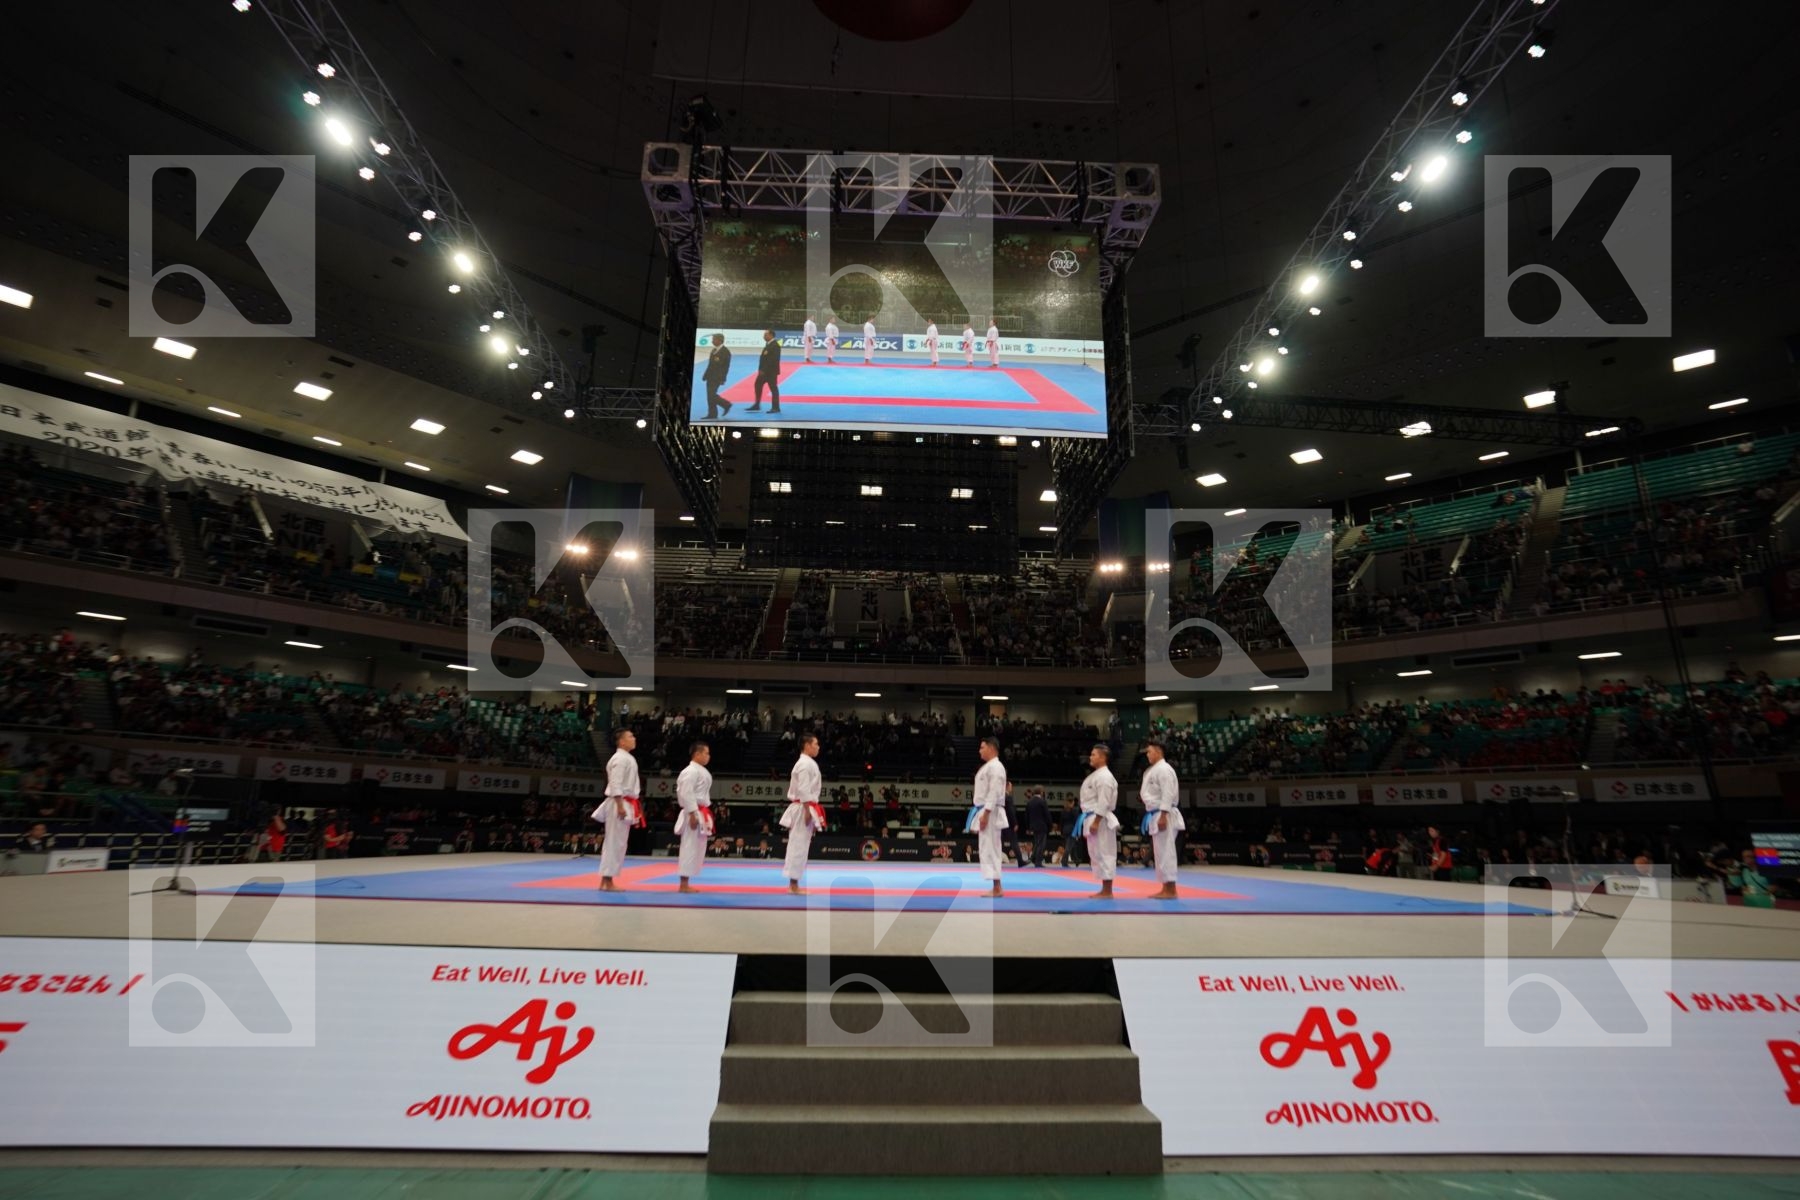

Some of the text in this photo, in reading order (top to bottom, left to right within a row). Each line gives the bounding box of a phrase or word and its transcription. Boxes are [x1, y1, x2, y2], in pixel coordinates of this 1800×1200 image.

[861, 606, 878, 620] N
[289, 765, 338, 778] 日本生命
[392, 771, 434, 784] 日本生命
[483, 777, 520, 789] 日本生命
[562, 782, 595, 793] 日本生命
[1634, 782, 1696, 796] 日本生命
[746, 785, 783, 796] 日本生命
[1306, 790, 1346, 801] 日本生命
[1402, 788, 1449, 800] 日本生命
[1219, 792, 1255, 803] 日本生命
[432, 964, 648, 986] Eat Well, Live Well.
[1198, 975, 1406, 994] Eat Well, Live Well.
